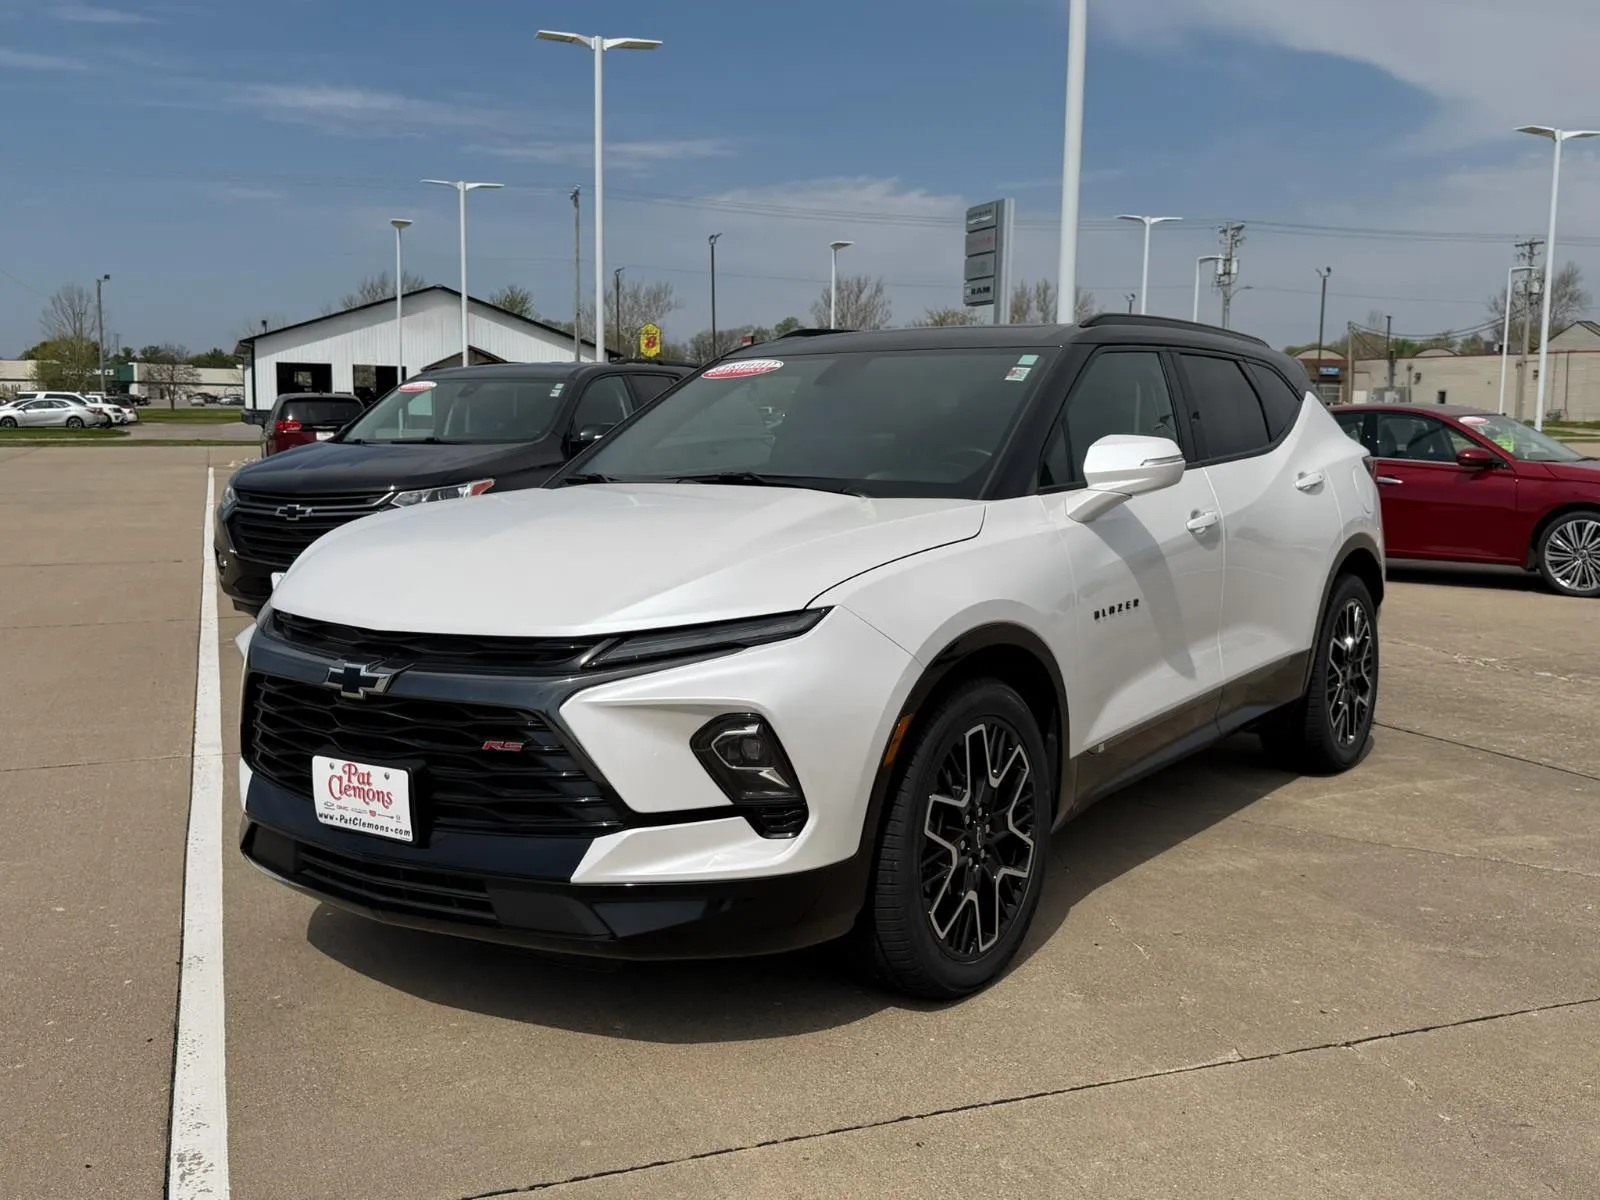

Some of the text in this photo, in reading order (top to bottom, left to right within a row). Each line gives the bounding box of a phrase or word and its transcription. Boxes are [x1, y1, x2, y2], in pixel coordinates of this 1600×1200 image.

[1094, 598, 1139, 620] BLAZER
[481, 740, 524, 752] RS
[341, 763, 373, 787] Pat
[328, 774, 393, 810] Clemons
[318, 811, 411, 837] www.PatClemons.com
